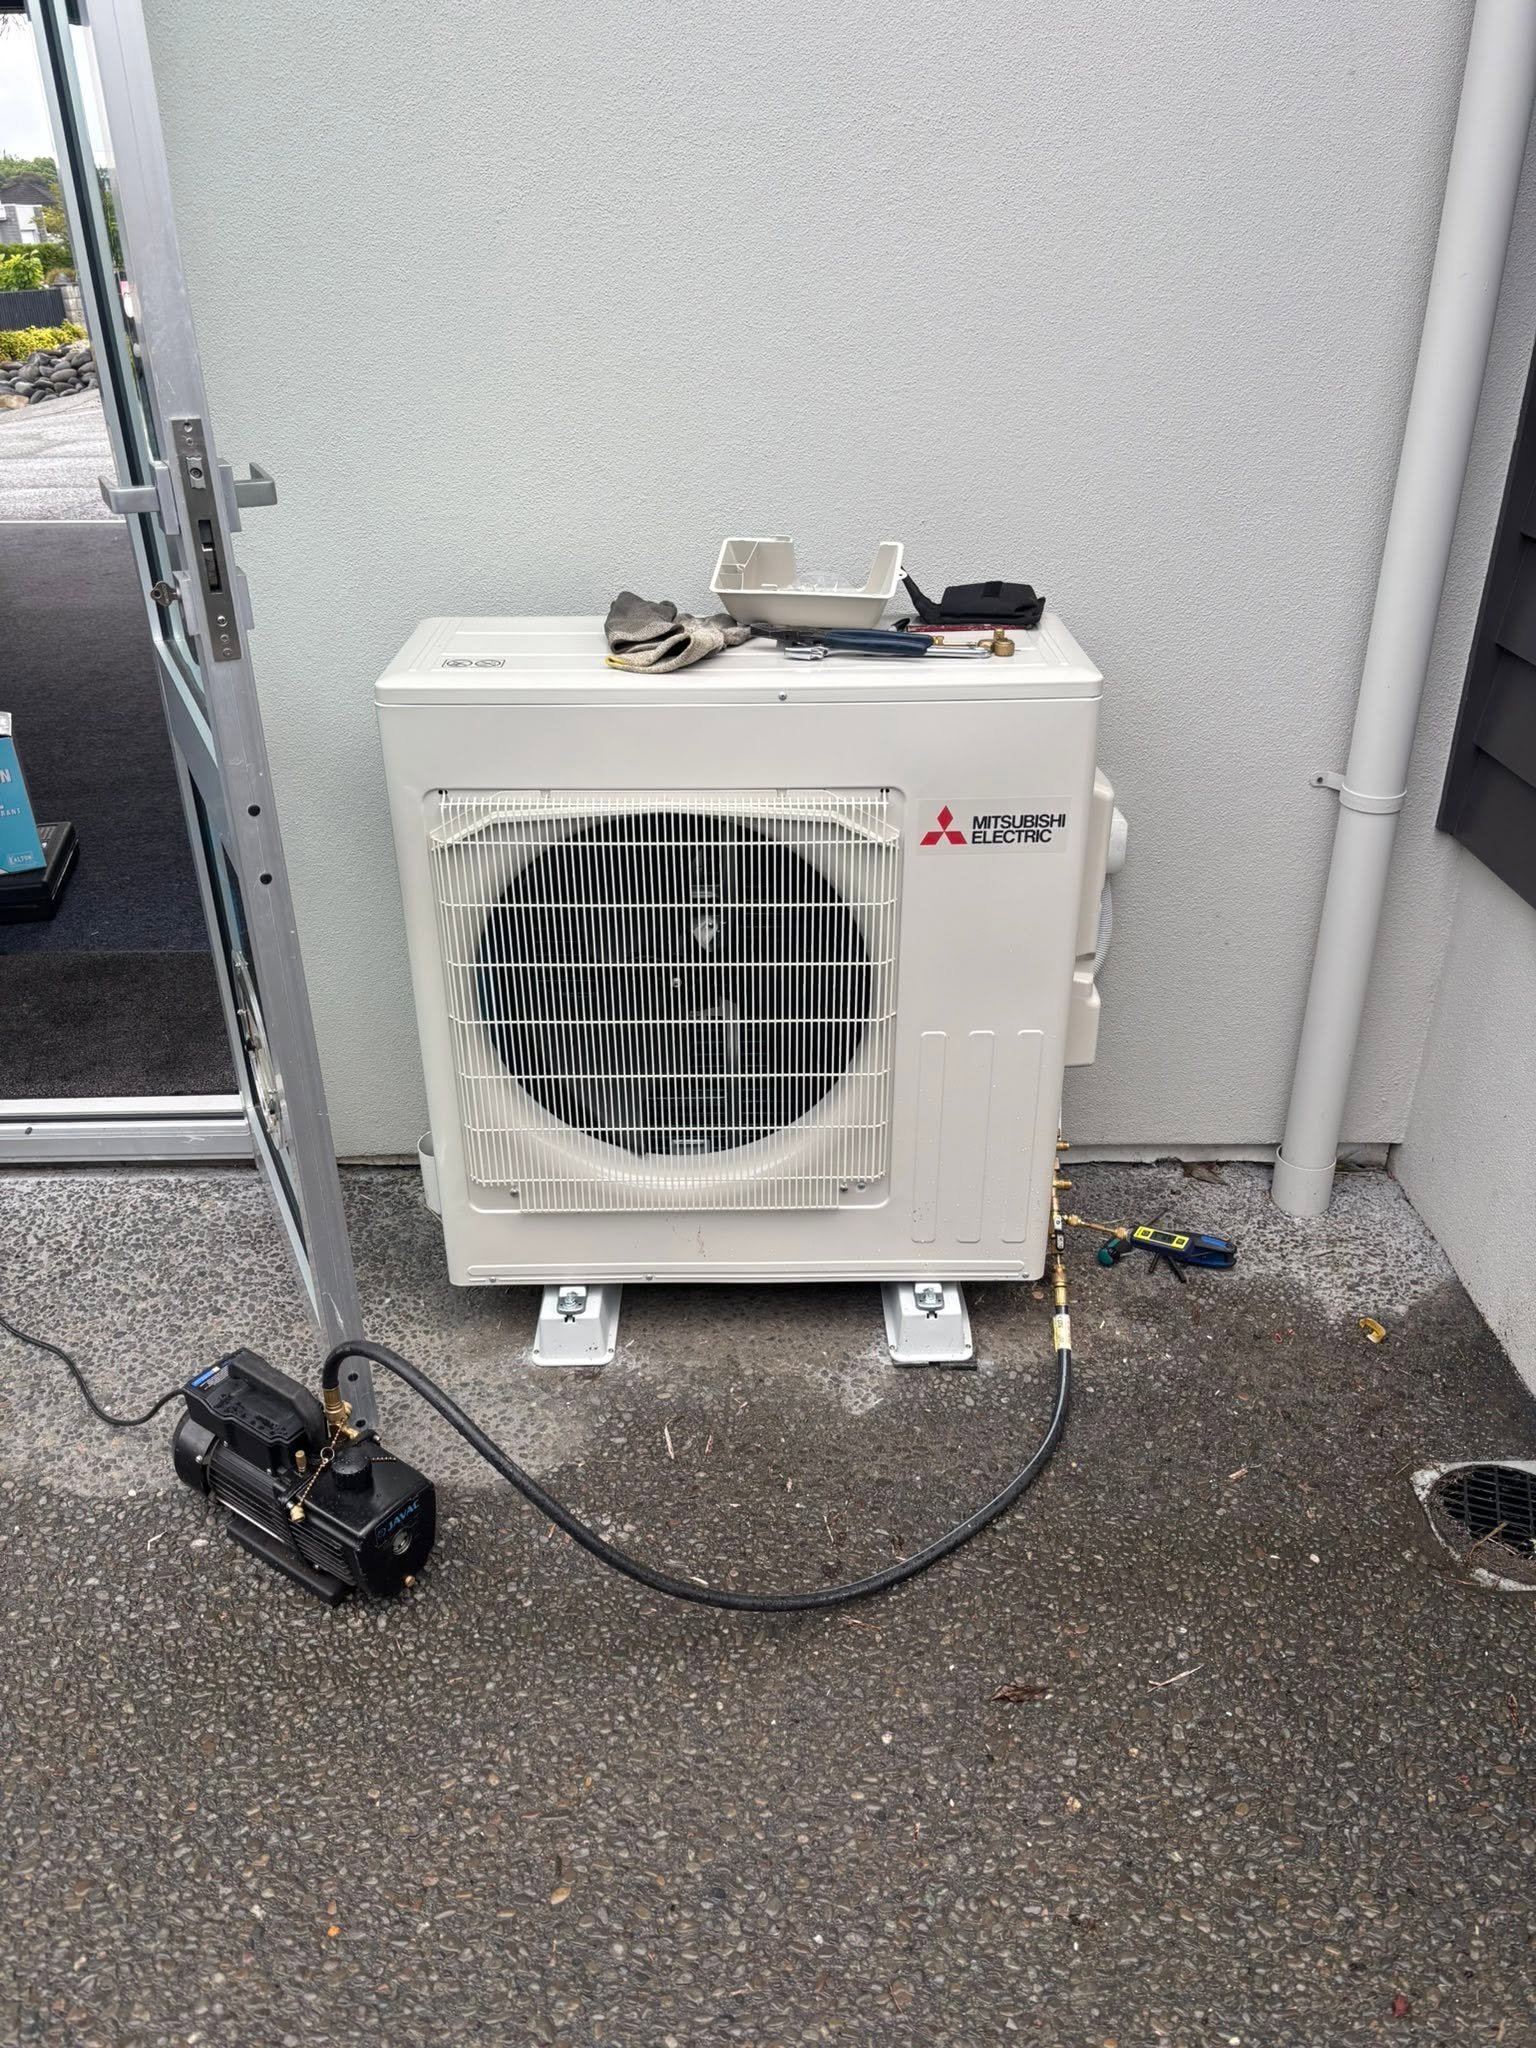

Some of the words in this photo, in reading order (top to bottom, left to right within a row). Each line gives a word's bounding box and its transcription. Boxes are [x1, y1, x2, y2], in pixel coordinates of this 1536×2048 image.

[972, 813, 1067, 830] MITSUBISHI
[971, 829, 1053, 844] ELECTRIC
[387, 1499, 420, 1532] JAVAC
